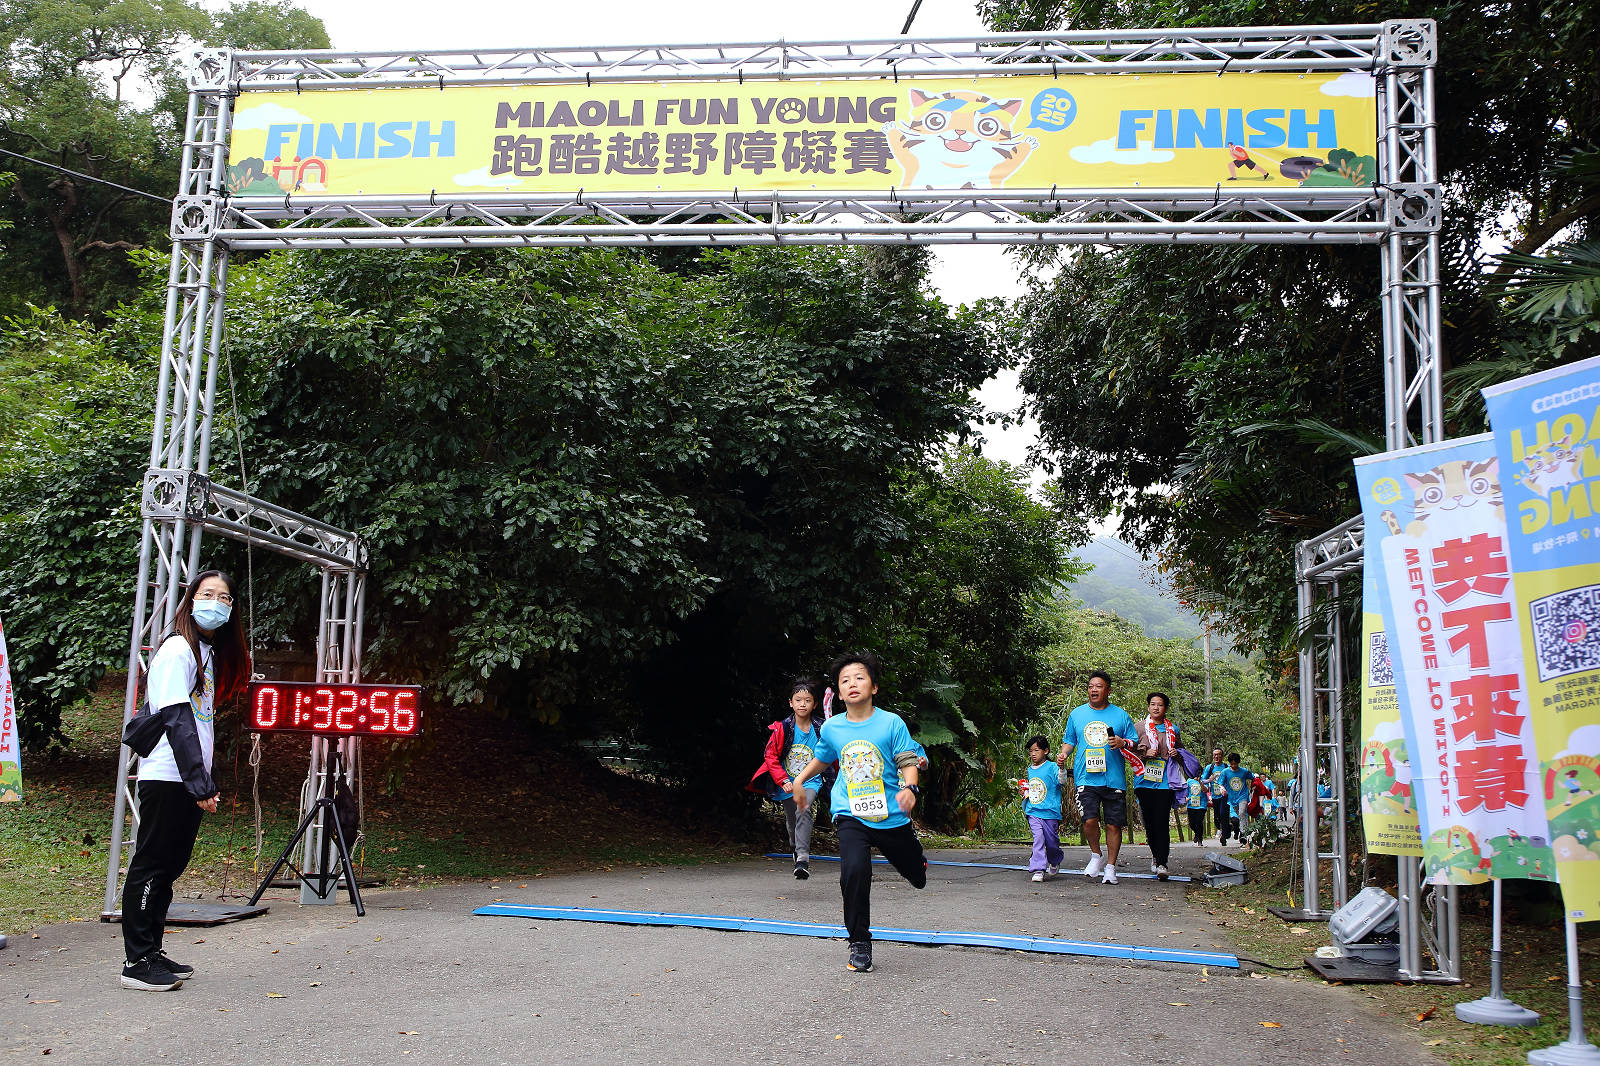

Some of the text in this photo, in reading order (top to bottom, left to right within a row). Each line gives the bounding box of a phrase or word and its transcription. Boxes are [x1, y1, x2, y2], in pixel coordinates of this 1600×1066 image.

[494, 96, 898, 128] MIAOLI FUN YOUNG
[1036, 107, 1067, 126] 25
[1041, 93, 1071, 111] 20
[264, 120, 456, 161] FINISH
[1117, 108, 1337, 150] FINISH
[490, 130, 896, 177] 跑酷越野障礙賽
[0, 679, 12, 753] MIAOLI
[256, 687, 415, 732] 01:32:56
[854, 799, 884, 812] 0953
